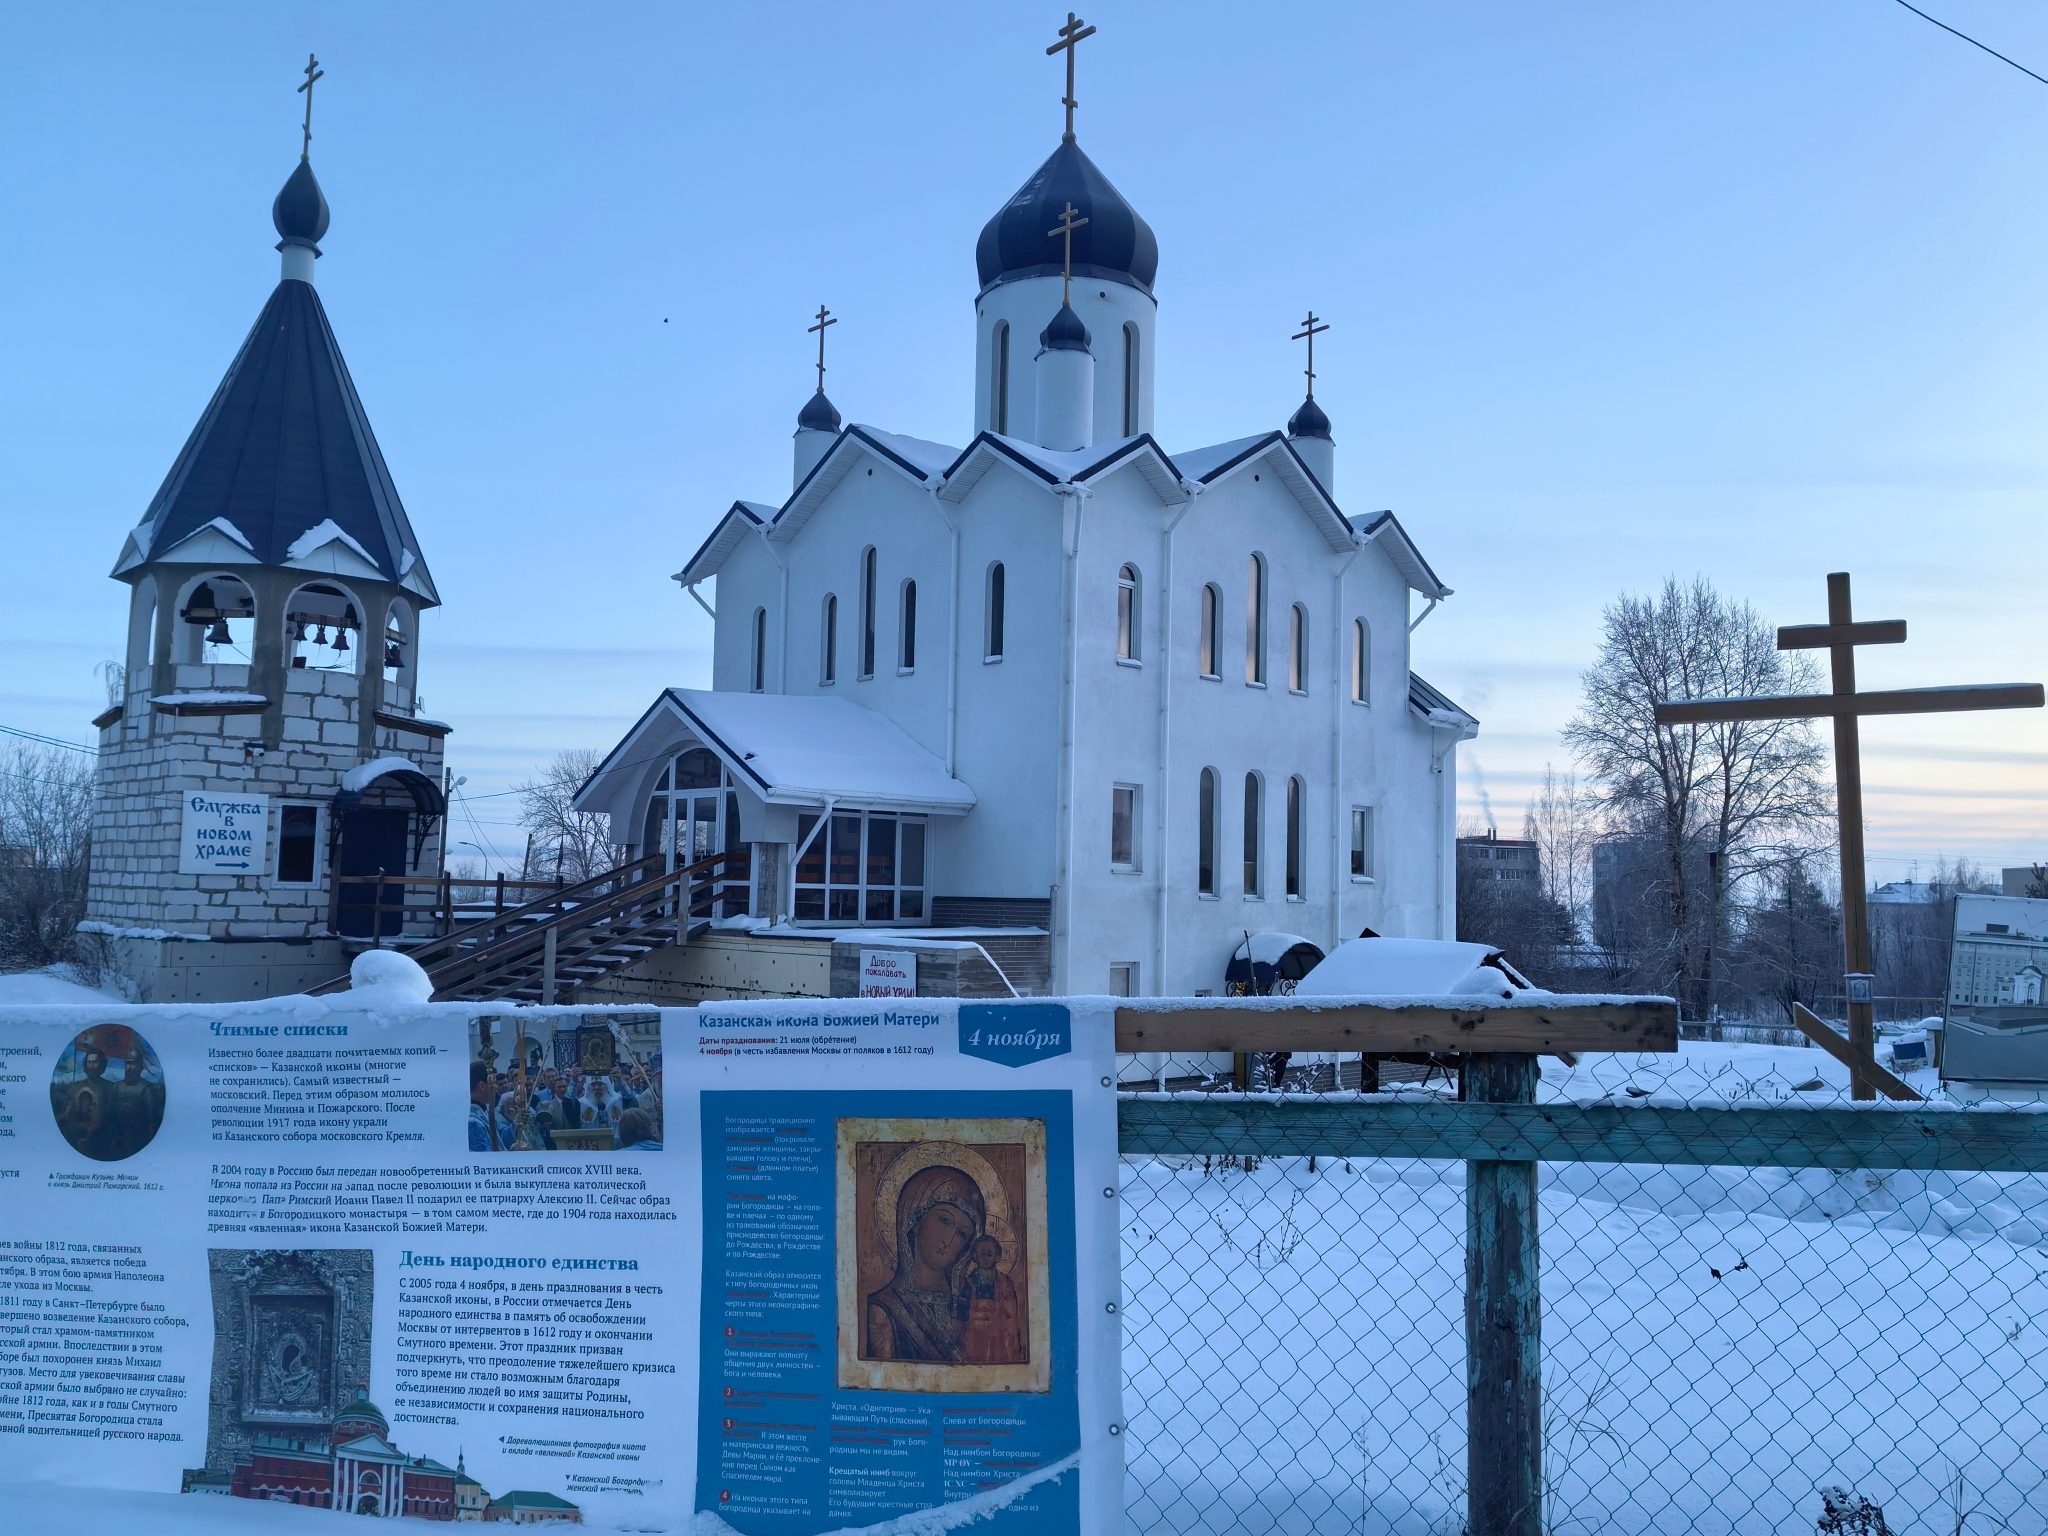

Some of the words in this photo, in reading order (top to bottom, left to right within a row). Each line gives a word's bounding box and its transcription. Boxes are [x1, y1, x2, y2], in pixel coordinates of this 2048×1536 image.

[870, 955, 896, 969] Добро
[865, 969, 906, 978] пожаловать
[699, 1015, 772, 1027] Казанская
[883, 1012, 939, 1028] Матери
[209, 1022, 279, 1036] Чтимые
[283, 1025, 348, 1036] списки
[699, 1036, 719, 1045] Даты
[779, 1035, 788, 1043] 21
[967, 1028, 980, 1045] 4
[986, 1029, 1061, 1049] ноября
[208, 1048, 253, 1057] Известно
[255, 1048, 283, 1057] более
[285, 1050, 332, 1058] двадцати
[335, 1047, 402, 1057] почитаемых
[404, 1045, 436, 1055] копий
[699, 1047, 705, 1055] 4
[706, 1047, 732, 1056] ноября
[734, 1047, 741, 1056] (в
[765, 1046, 809, 1054] избавления
[811, 1046, 841, 1054] Москвы
[893, 1045, 912, 1053] 1612
[913, 1045, 934, 1055] году)
[271, 1062, 323, 1072] Казанской
[325, 1063, 361, 1071] иконы
[364, 1061, 406, 1071] (многие
[209, 1077, 220, 1085] не
[222, 1077, 291, 1087] сохранились).
[293, 1076, 329, 1086] Самый
[332, 1074, 389, 1084] известный
[210, 1090, 270, 1099] московский.
[272, 1090, 302, 1101] Перед
[305, 1091, 332, 1099] этим
[334, 1088, 378, 1100] образом
[210, 1105, 261, 1113] ополчение
[263, 1104, 305, 1113] Минина
[307, 1105, 315, 1113] и
[317, 1103, 382, 1114] Пожарского.
[385, 1102, 415, 1112] После
[211, 1119, 264, 1128] революции
[267, 1117, 289, 1127] 1917
[293, 1119, 316, 1127] года
[319, 1119, 350, 1128] икону
[352, 1118, 388, 1128] украли
[725, 1116, 767, 1124] Богородица
[212, 1132, 222, 1140] из
[224, 1131, 280, 1141] Казанского
[282, 1131, 317, 1142] собора
[385, 1130, 425, 1143] Кремля.
[756, 1155, 780, 1163] голову
[212, 1164, 218, 1173] В
[220, 1164, 242, 1174] 2004
[244, 1167, 267, 1177] году
[269, 1167, 274, 1175] в
[277, 1165, 313, 1175] Россию
[315, 1165, 335, 1176] был
[337, 1168, 377, 1177] передан
[473, 1164, 544, 1174] Ватиканский
[546, 1166, 582, 1174] список
[584, 1164, 612, 1174] XVIII
[615, 1167, 642, 1175] века.
[207, 1223, 246, 1233] древняя
[309, 1224, 341, 1232] икона
[344, 1222, 399, 1232] Казанской
[402, 1222, 442, 1231] Божией
[445, 1221, 487, 1234] Матери.
[726, 1232, 778, 1242] приснодевство
[779, 1232, 825, 1242] Богородицы:
[13, 1240, 42, 1249] войны
[45, 1241, 65, 1250] 1812
[67, 1243, 90, 1252] года,
[92, 1245, 142, 1253] связанных
[398, 1250, 445, 1268] День
[449, 1256, 547, 1270] народного
[551, 1258, 639, 1270] единства
[725, 1269, 762, 1277] Казанский
[763, 1270, 784, 1279] образ
[399, 1277, 406, 1288] С
[408, 1277, 431, 1288] 2005
[434, 1281, 457, 1289] года
[459, 1279, 466, 1289] 4
[468, 1279, 508, 1292] ноября,
[510, 1282, 516, 1290] в
[518, 1283, 544, 1291] день
[546, 1283, 622, 1293] празднования
[625, 1285, 631, 1293] в
[633, 1285, 663, 1294] честь
[399, 1292, 452, 1303] Казанской
[454, 1296, 491, 1306] иконы,
[494, 1297, 500, 1305] в
[502, 1295, 539, 1306] России
[541, 1298, 602, 1308] отмечается
[604, 1297, 632, 1309] День
[42, 1313, 95, 1322] возведение
[97, 1314, 151, 1324] Казанского
[153, 1315, 189, 1327] собора,
[398, 1309, 452, 1319] народного
[454, 1311, 501, 1320] единства
[504, 1312, 510, 1320] в
[513, 1313, 551, 1321] память
[553, 1311, 566, 1322] об
[568, 1313, 646, 1324] освобождении
[723, 1358, 755, 1367] общения
[756, 1361, 774, 1369] двух
[28, 1366, 58, 1377] Место
[59, 1370, 77, 1378] для
[78, 1371, 156, 1381] увековечивания
[157, 1374, 185, 1383] славы
[27, 1426, 100, 1437] водительницей
[102, 1430, 145, 1440] русского
[147, 1432, 183, 1442] народа.
[506, 1436, 571, 1448] Дореволюционная
[572, 1440, 620, 1450] фотография
[507, 1447, 533, 1455] оклада
[534, 1449, 575, 1457] «явленной»
[576, 1450, 615, 1459] Казанской
[721, 1471, 762, 1480] Спасителем
[763, 1475, 783, 1483] мира.
[828, 1466, 868, 1475] Крещатый
[870, 1468, 890, 1476] нимб
[891, 1470, 917, 1478] вокруг
